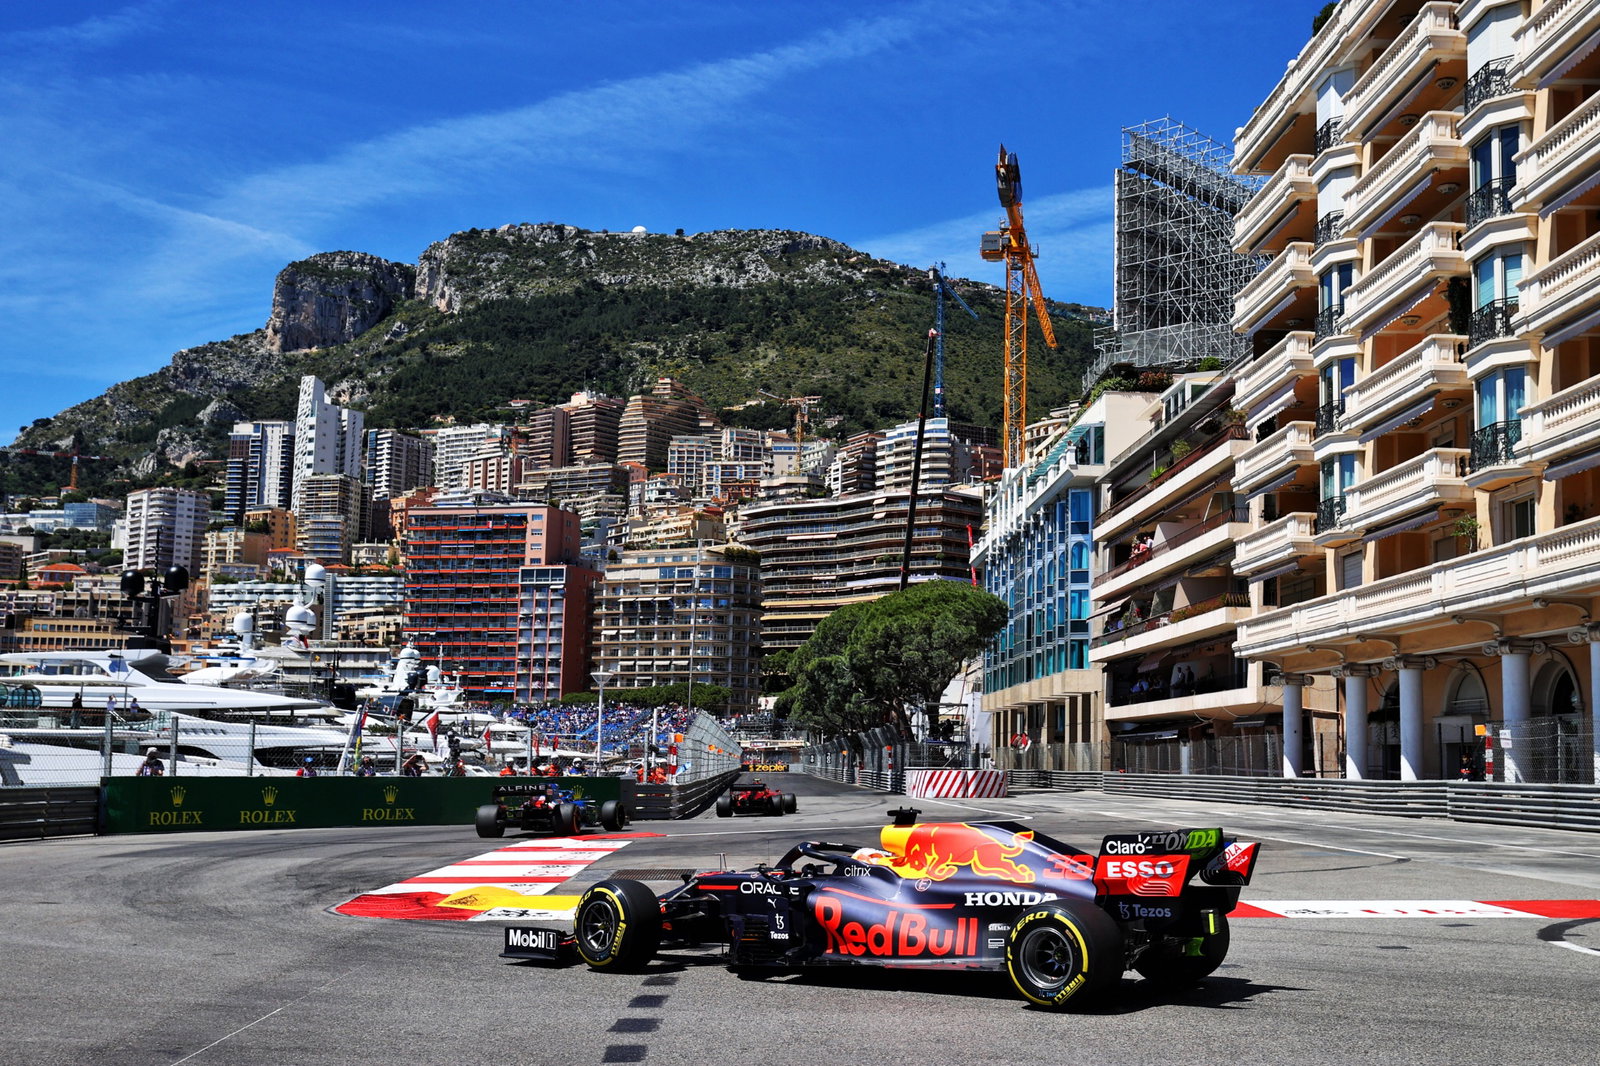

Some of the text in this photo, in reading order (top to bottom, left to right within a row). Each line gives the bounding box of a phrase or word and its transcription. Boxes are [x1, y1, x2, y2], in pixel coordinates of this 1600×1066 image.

[150, 811, 202, 825] ROLEX
[240, 811, 296, 823] ROLEX
[362, 808, 415, 820] ROLEX
[844, 865, 871, 877] citrix
[1107, 861, 1174, 878] ESSO
[1132, 904, 1172, 917] Tezos
[1010, 911, 1048, 942] ZERO
[509, 929, 545, 949] Mobil
[770, 931, 789, 940] Tezos
